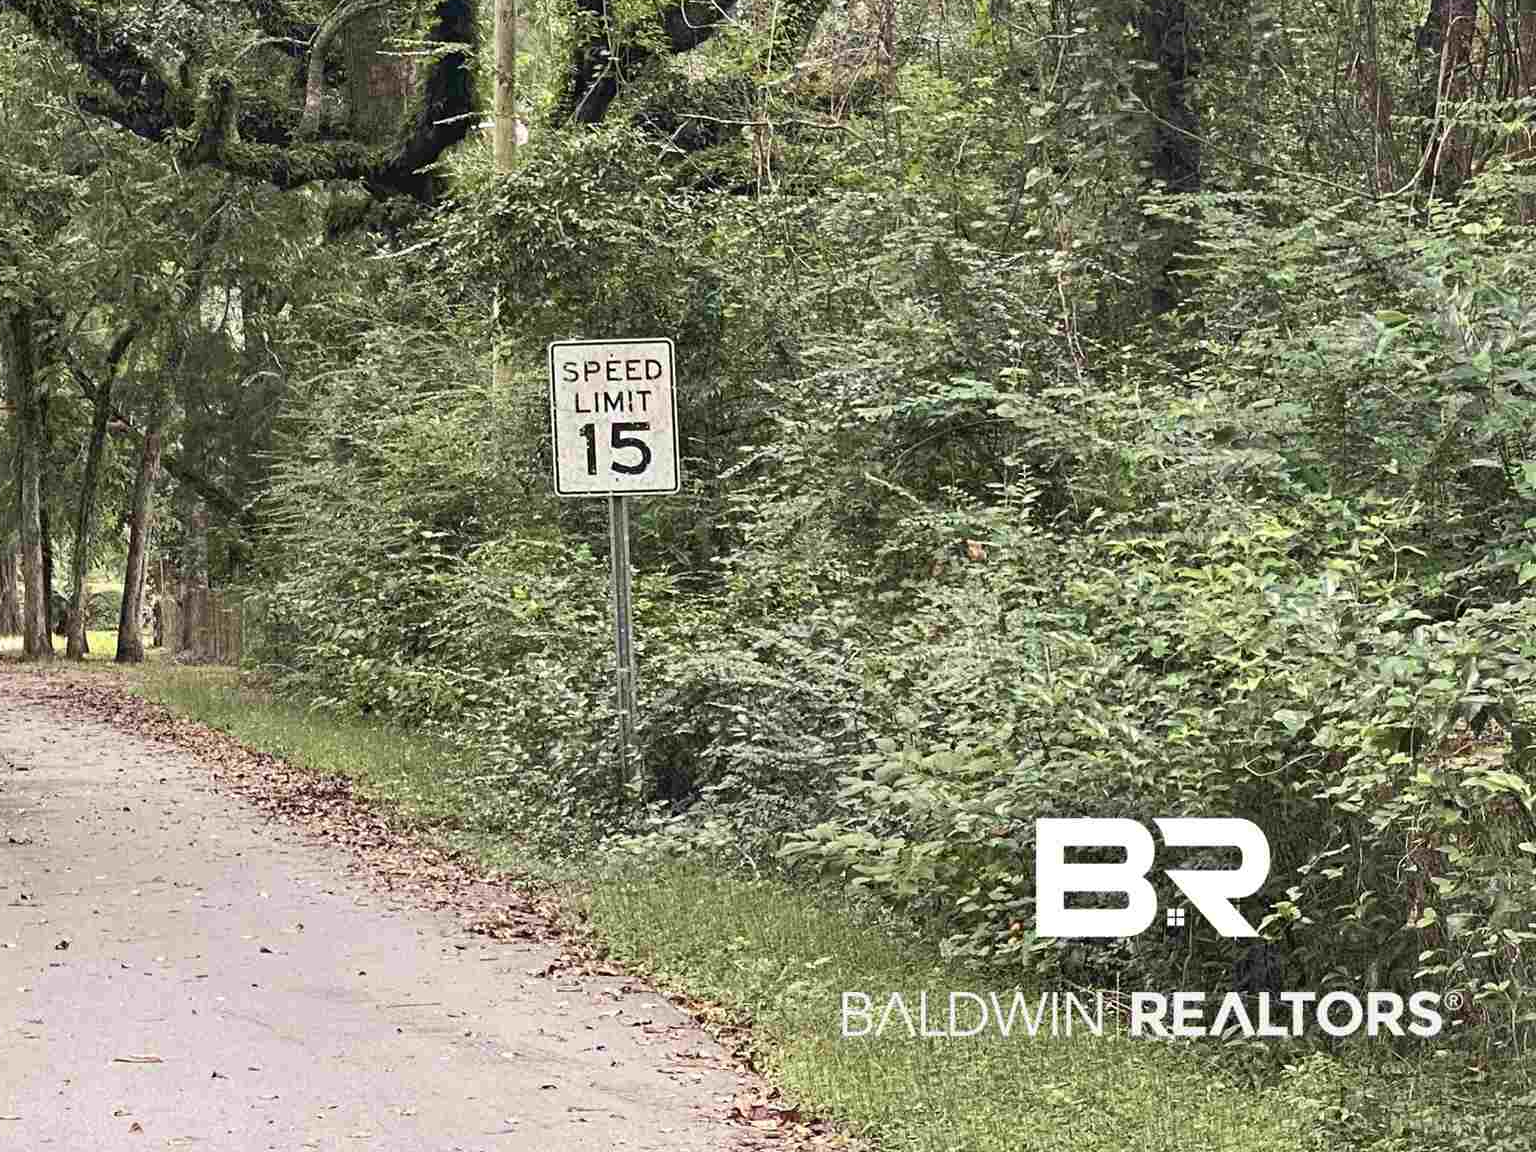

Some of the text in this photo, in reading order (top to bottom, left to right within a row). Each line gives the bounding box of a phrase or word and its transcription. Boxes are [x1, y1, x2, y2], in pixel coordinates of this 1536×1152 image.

[562, 359, 663, 382] SPEED
[575, 390, 652, 413] LIMIT
[579, 421, 652, 476] 15
